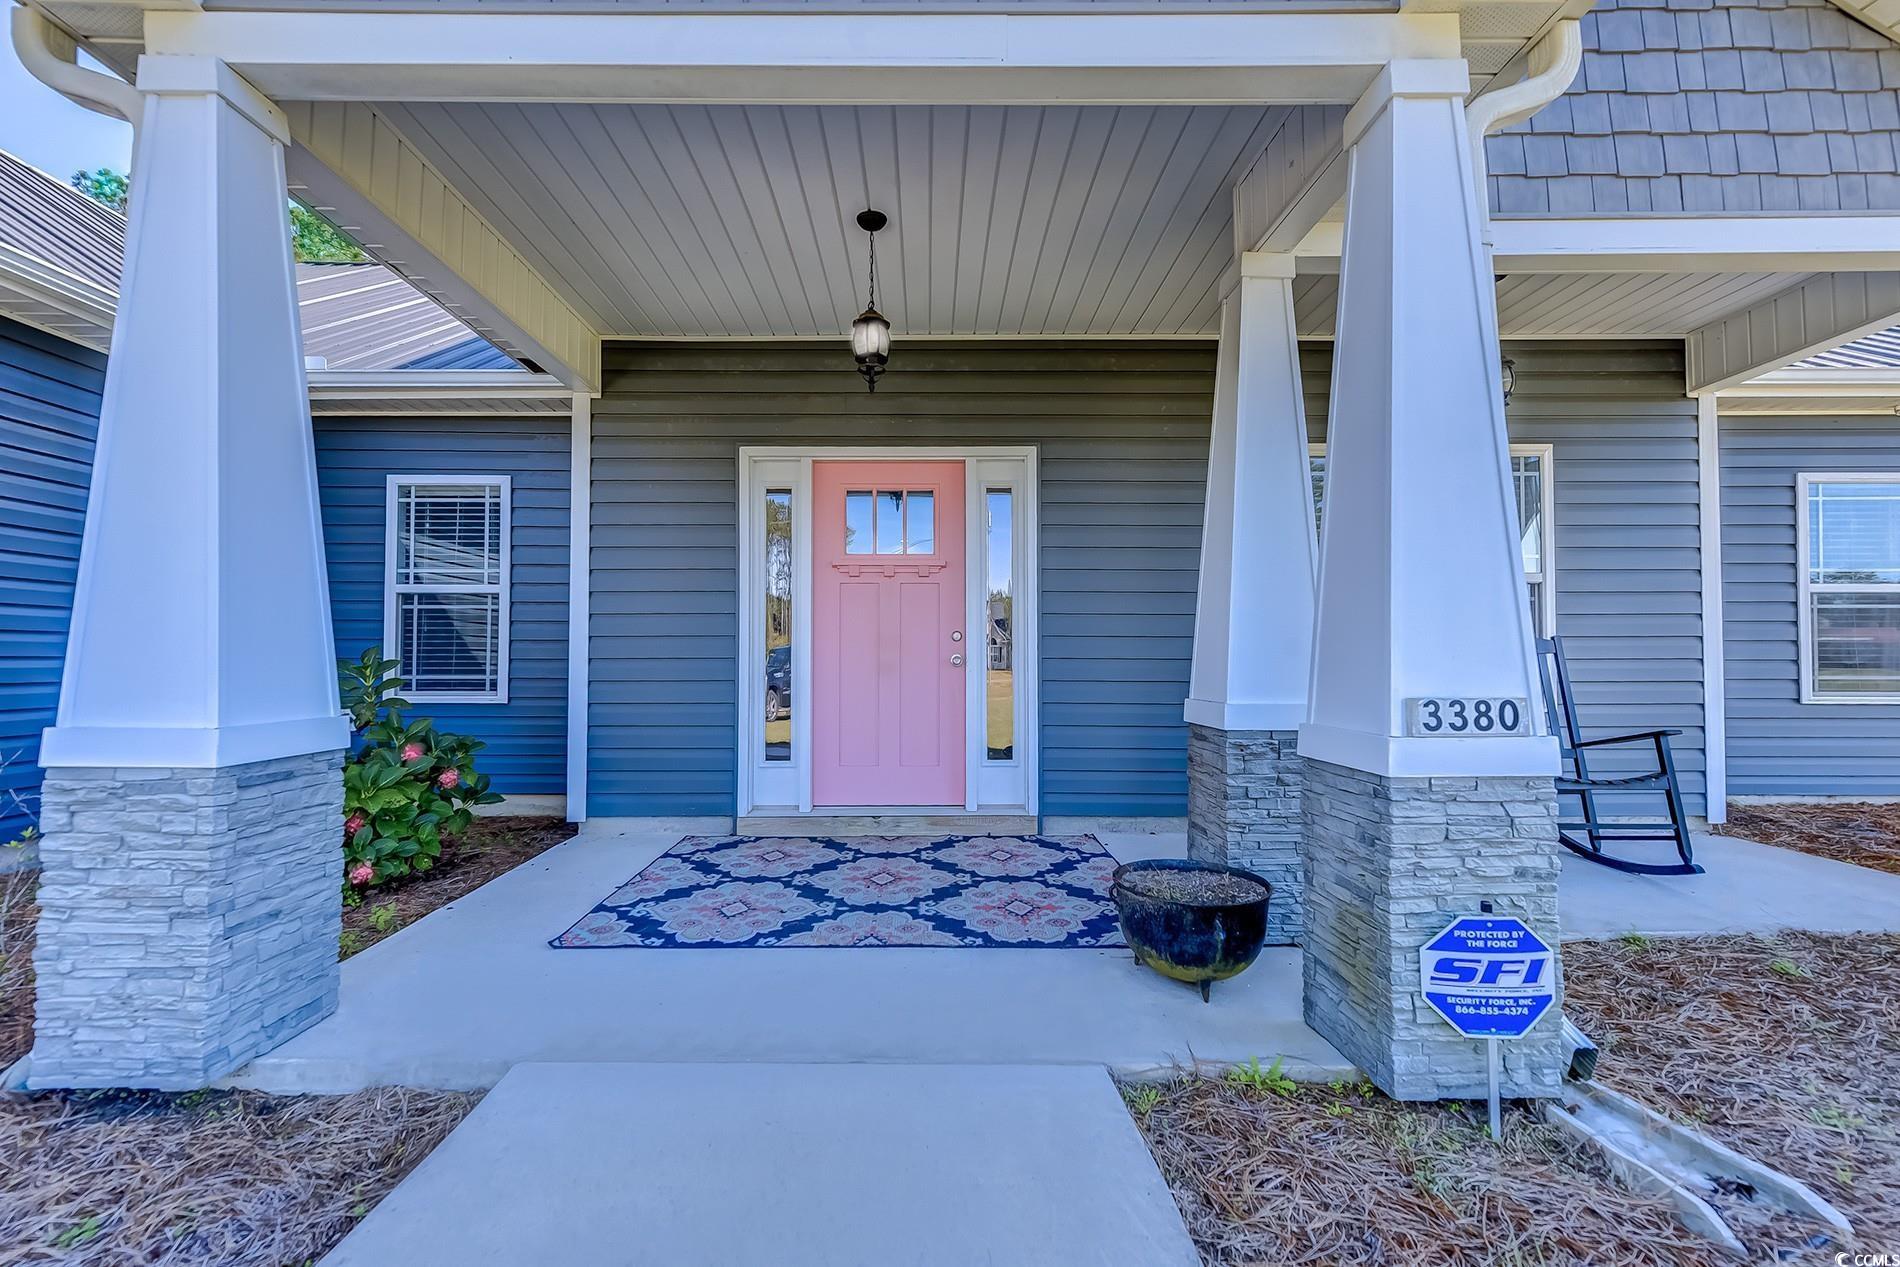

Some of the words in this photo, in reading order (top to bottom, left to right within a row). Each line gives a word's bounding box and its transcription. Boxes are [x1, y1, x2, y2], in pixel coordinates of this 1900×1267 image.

[1422, 699, 1520, 732] 3380
[1453, 930, 1510, 939] PROTECTED
[1511, 930, 1525, 939] BY
[1466, 940, 1485, 948] THE
[1487, 940, 1518, 948] FORCE
[1430, 957, 1547, 984] SFI
[1446, 996, 1487, 1006] SECURITY
[1488, 998, 1517, 1007] FORCE,
[1518, 998, 1537, 1006] INC.
[1455, 1005, 1529, 1016] 866-855-4374
